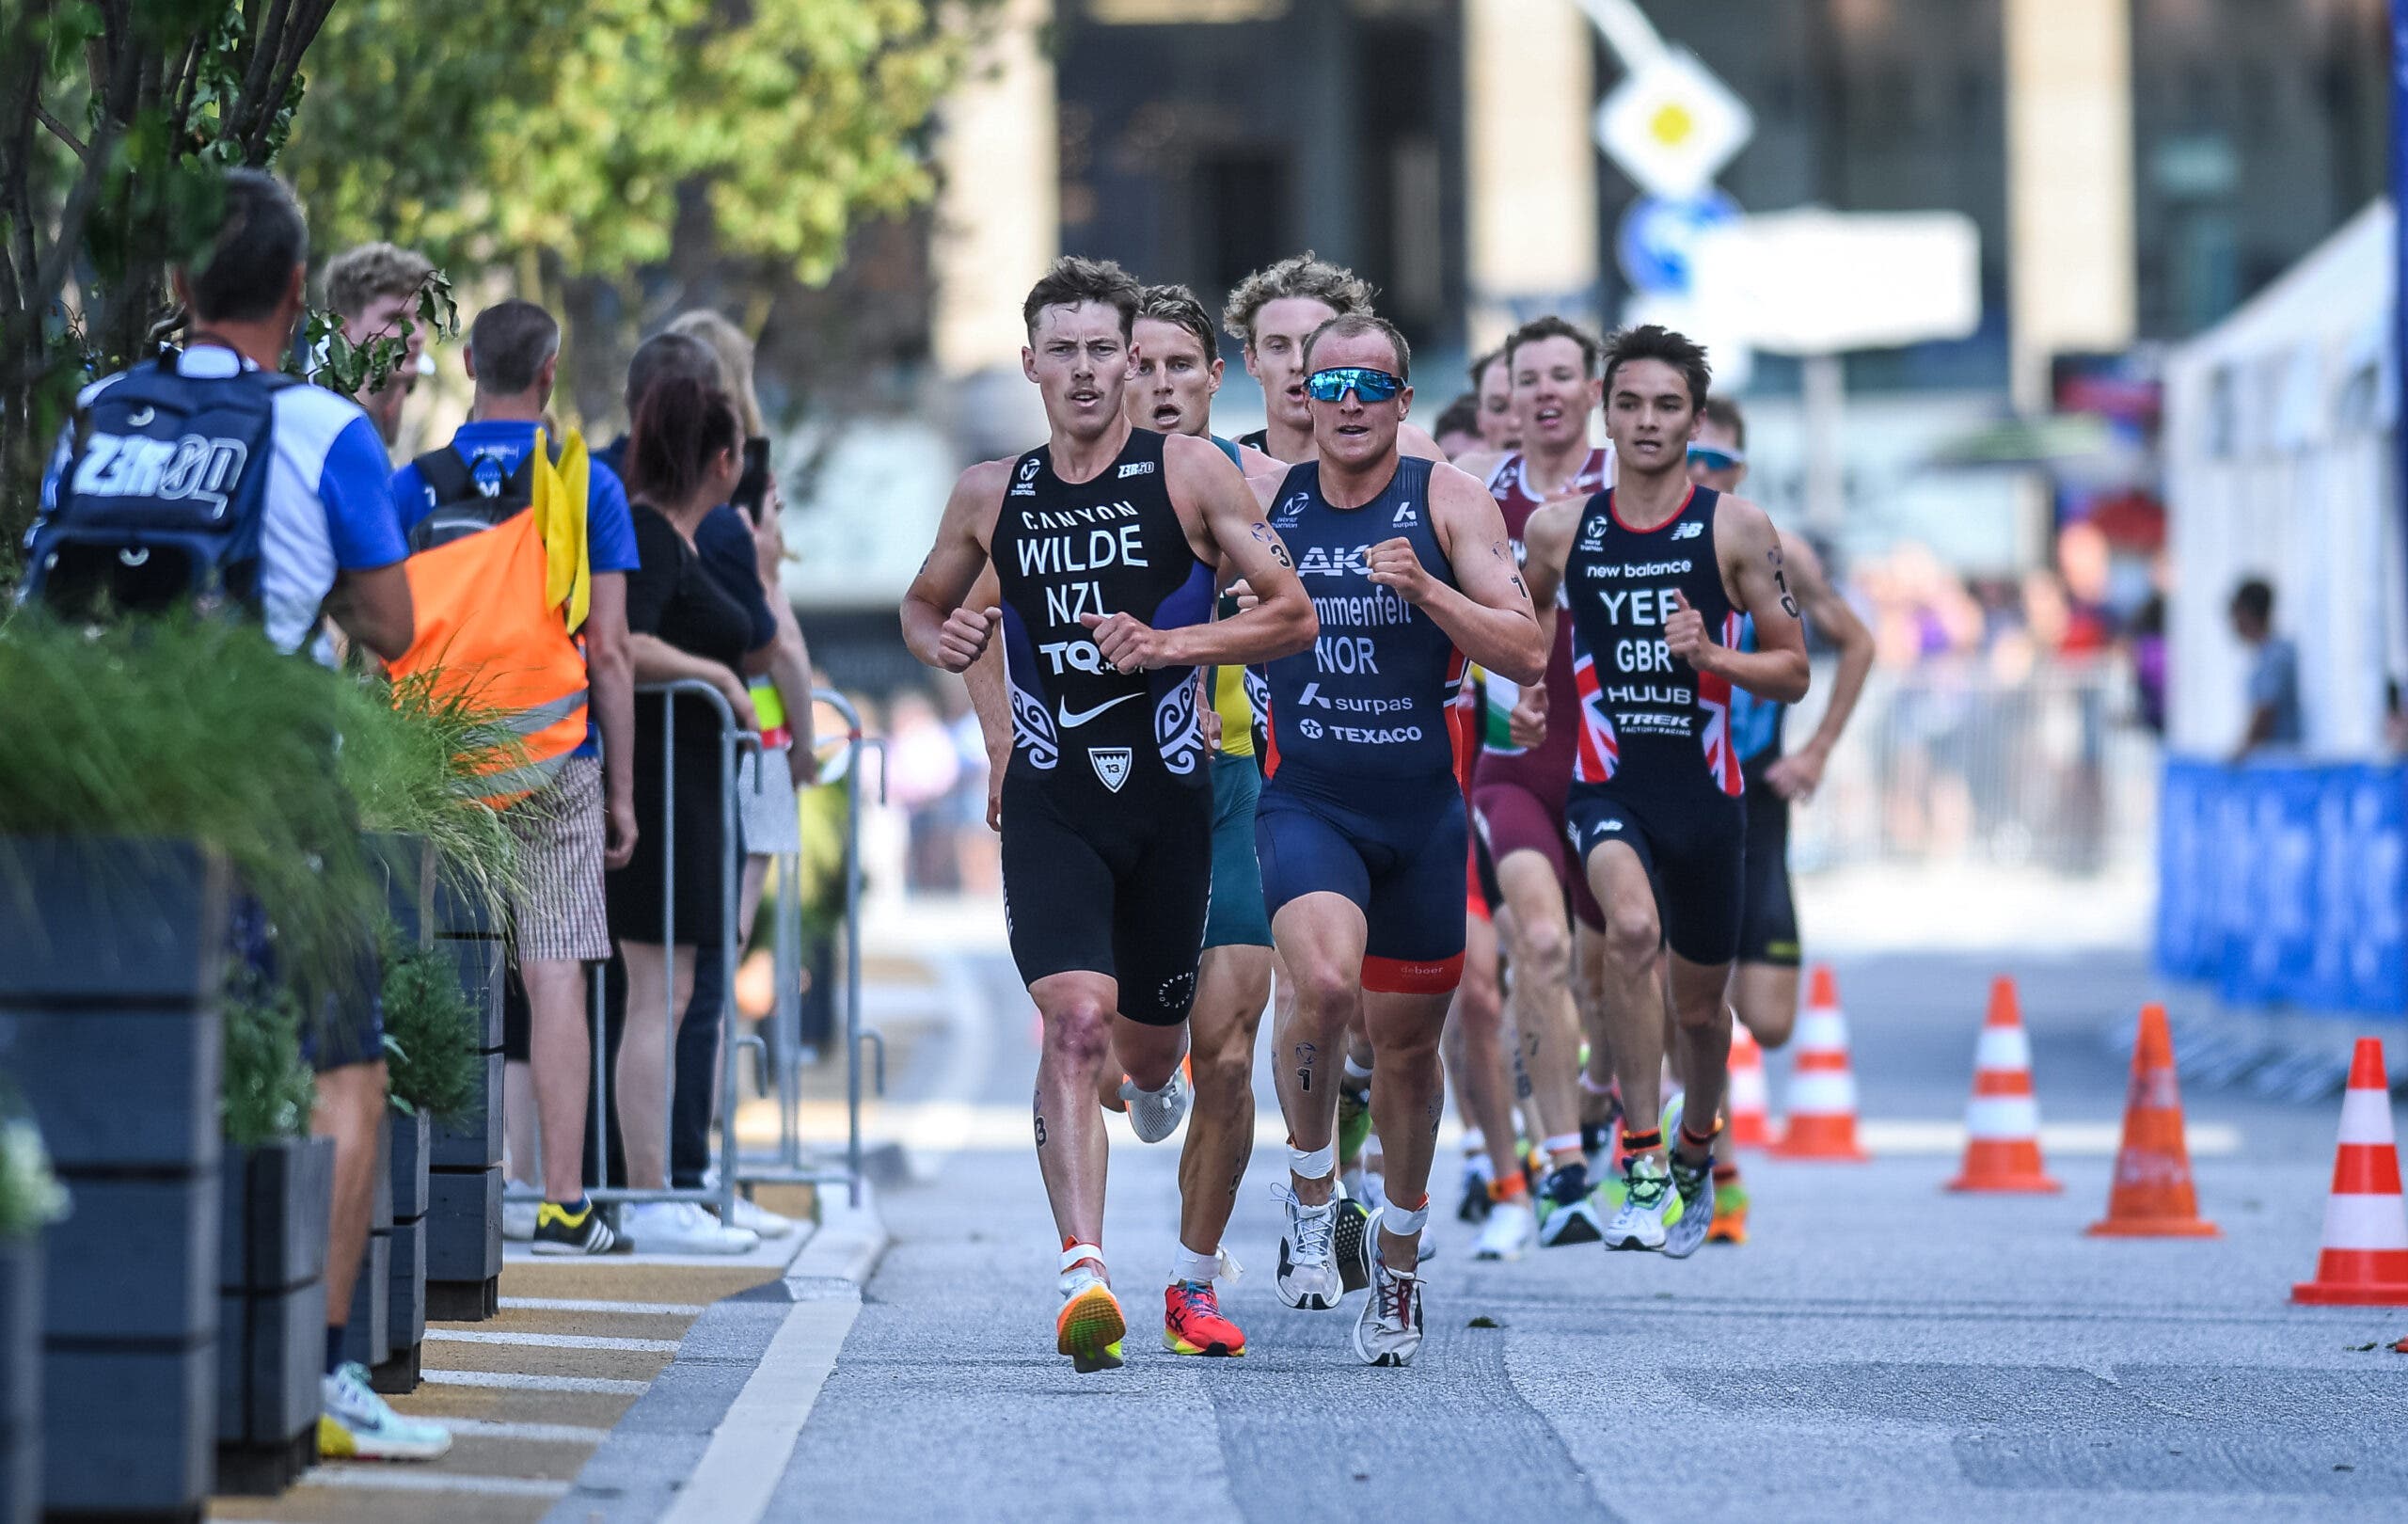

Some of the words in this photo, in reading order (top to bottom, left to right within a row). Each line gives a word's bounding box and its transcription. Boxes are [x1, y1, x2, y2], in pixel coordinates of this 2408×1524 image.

[1022, 500, 1139, 530] CANYON
[1017, 524, 1149, 577] WILDE
[1270, 543, 1291, 569] 3
[1587, 565, 1622, 579] new
[1624, 560, 1692, 578] balance
[1045, 580, 1117, 627] NZL
[1312, 584, 1412, 627] mmenfelt
[1315, 636, 1380, 675] NOR
[1617, 639, 1674, 673] GBR
[1335, 697, 1413, 715] surpas
[1608, 685, 1692, 706] HUUB
[1615, 713, 1693, 727] TREK
[1658, 727, 1691, 736] RACING
[1329, 725, 1423, 744] TEXACO
[1105, 764, 1120, 773] 13
[1296, 1067, 1311, 1092] 1
